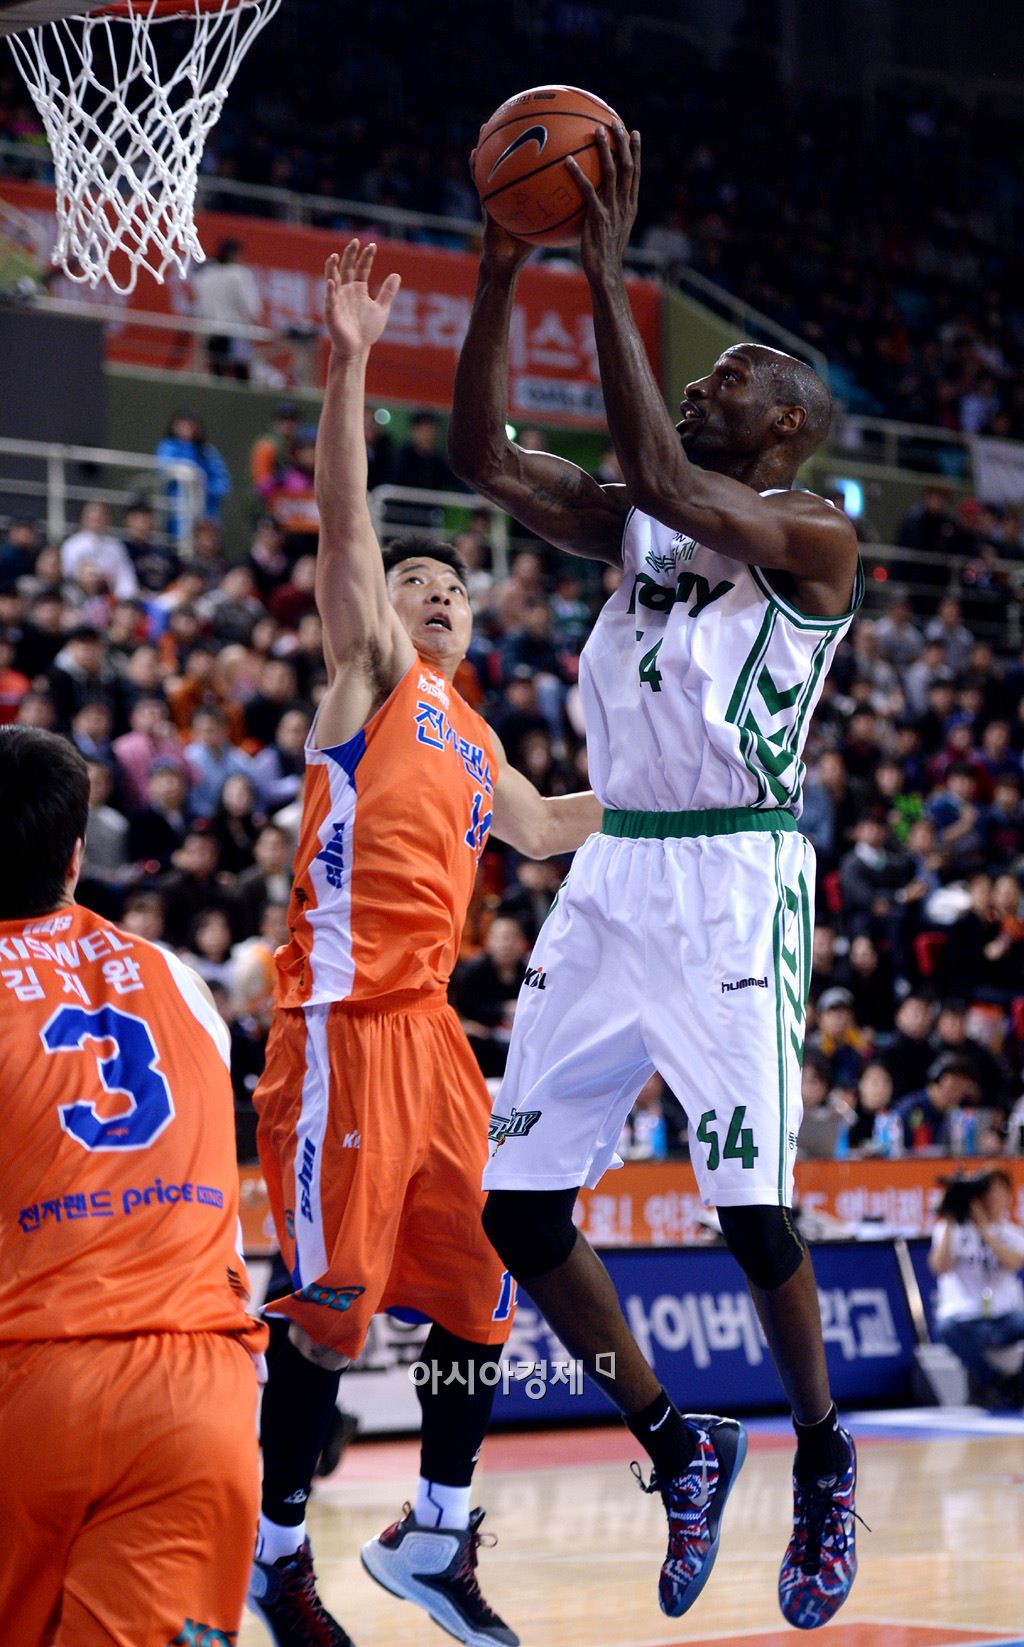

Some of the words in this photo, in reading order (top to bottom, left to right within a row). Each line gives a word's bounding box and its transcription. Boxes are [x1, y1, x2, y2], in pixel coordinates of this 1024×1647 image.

[721, 976, 769, 993] hummel
[39, 1003, 176, 1152] 3
[696, 1105, 760, 1171] 54
